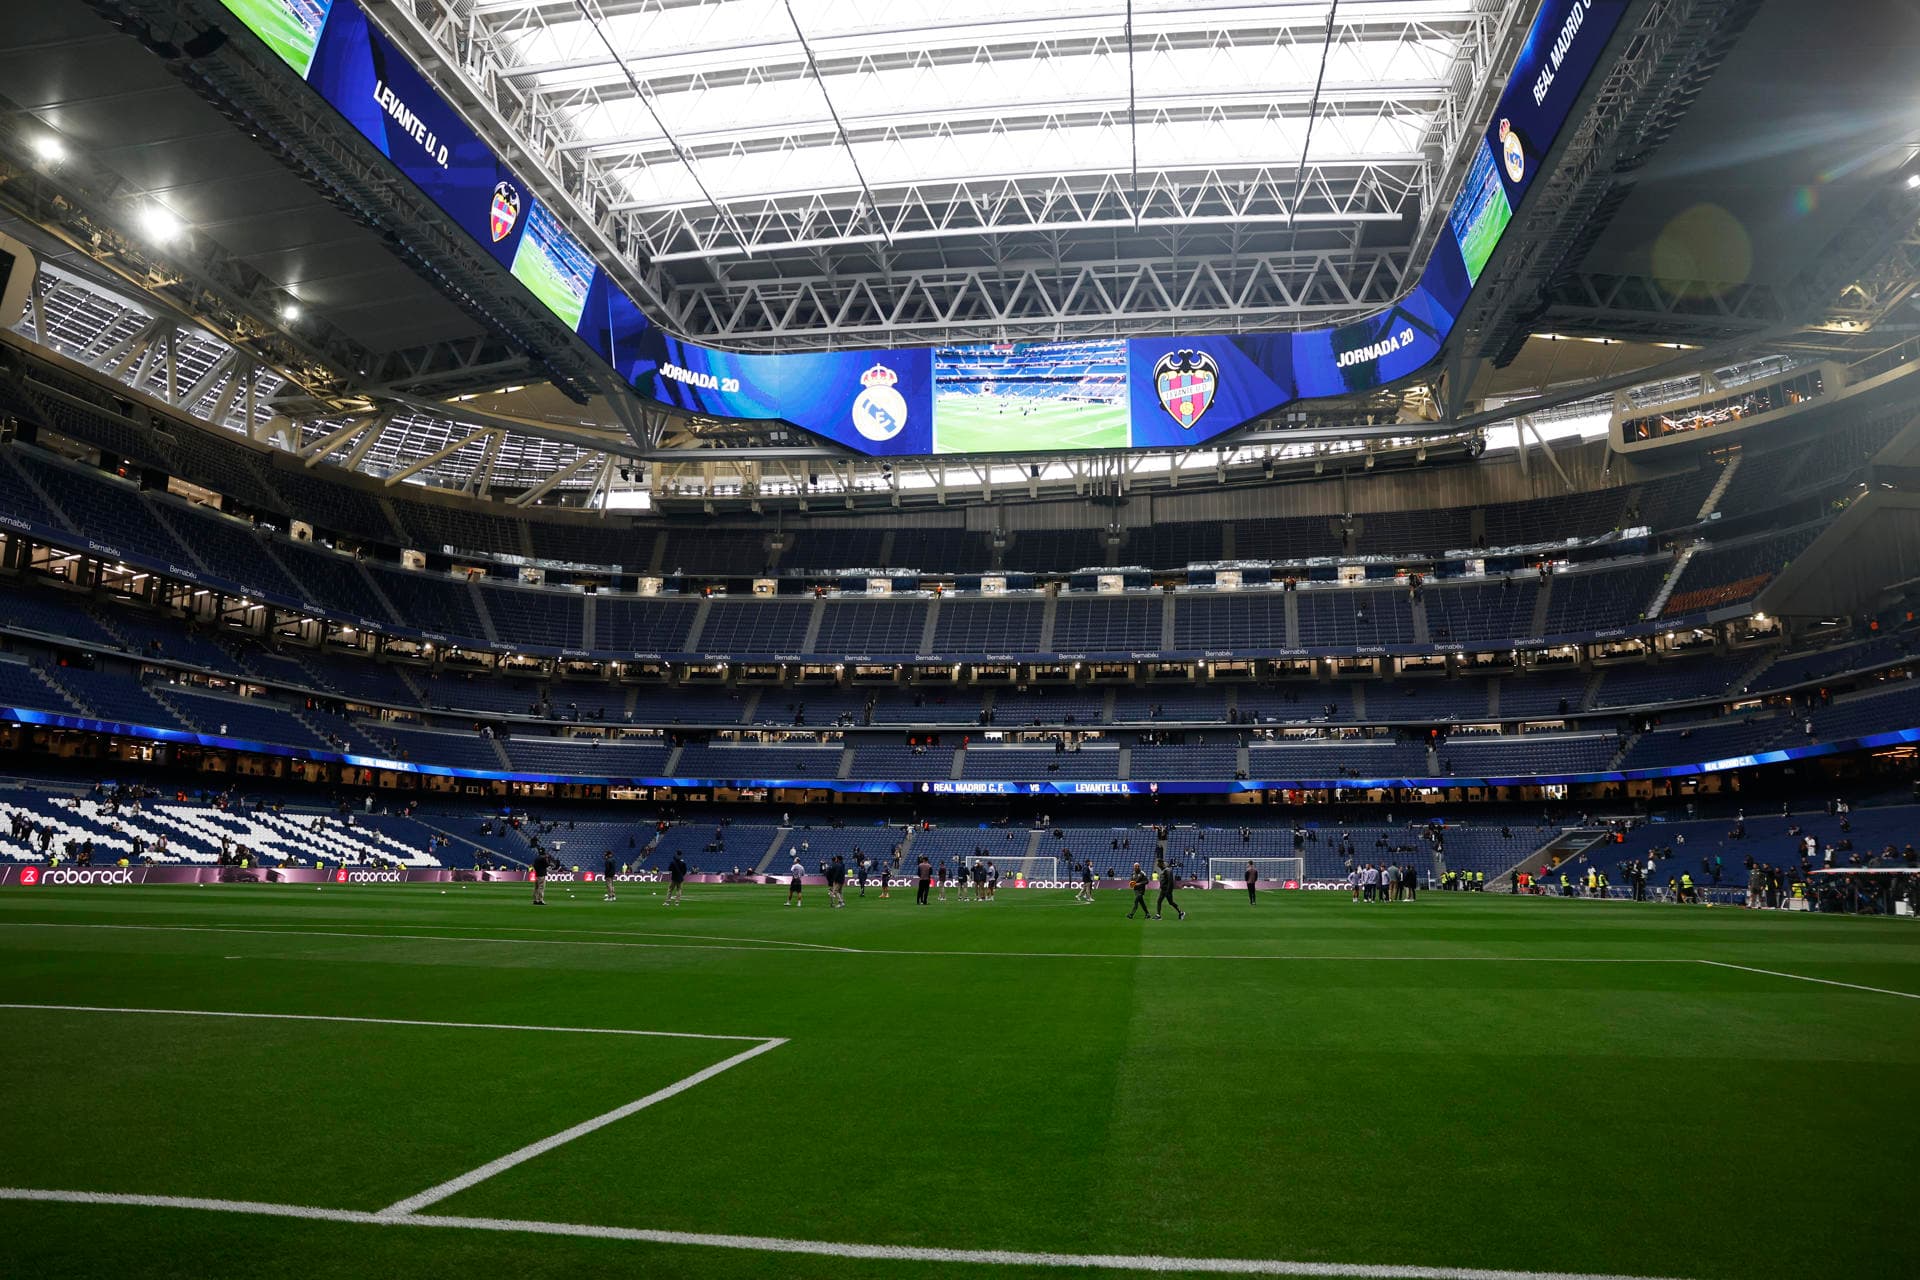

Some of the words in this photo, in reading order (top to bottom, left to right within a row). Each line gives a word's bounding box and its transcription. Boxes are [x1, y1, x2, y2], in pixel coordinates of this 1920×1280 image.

[1533, 63, 1555, 107] REAL
[1550, 1, 1584, 71] MADRID
[373, 80, 427, 145] LEVANTE
[425, 132, 437, 157] U.
[436, 144, 449, 170] D.
[1336, 336, 1400, 368] JORNADA
[1399, 328, 1414, 347] 20
[659, 362, 719, 390] JORNADA
[721, 377, 740, 393] 20
[933, 783, 954, 792] REAL
[955, 783, 987, 792] MADRID
[1030, 784, 1040, 792] VS
[1075, 783, 1111, 792] LEVANTE
[41, 867, 133, 884] roborock
[348, 870, 400, 882] roborock
